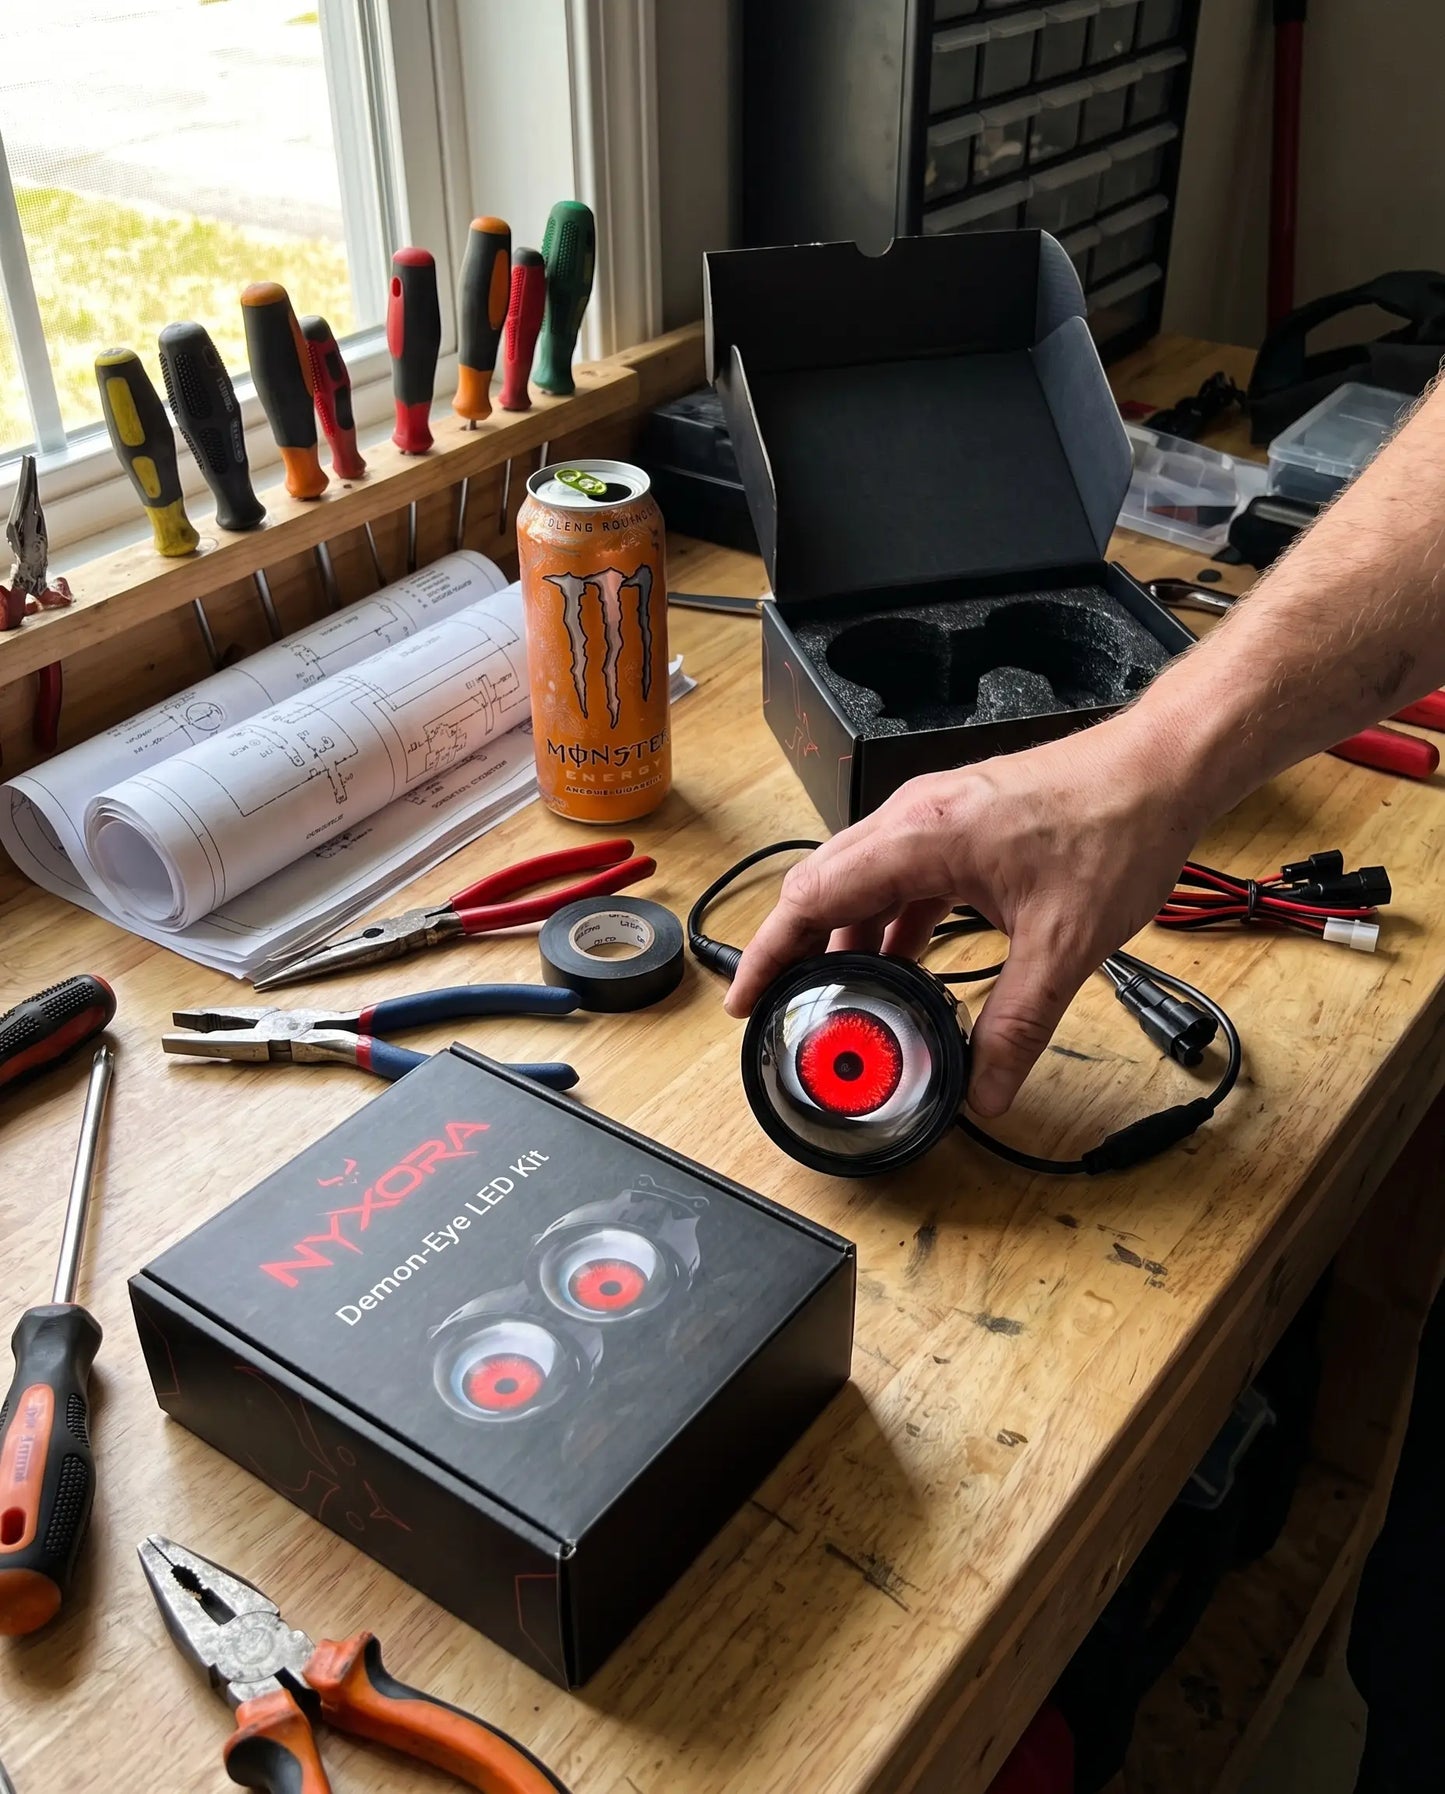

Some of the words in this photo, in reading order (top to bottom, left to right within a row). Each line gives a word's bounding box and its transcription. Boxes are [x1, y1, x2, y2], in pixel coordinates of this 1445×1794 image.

[565, 758, 660, 782] ENERGY
[260, 1121, 491, 1288] NYXORA
[335, 1213, 471, 1326] Demon-Eye
[465, 1176, 515, 1217] LED
[509, 1149, 550, 1178] Kit
